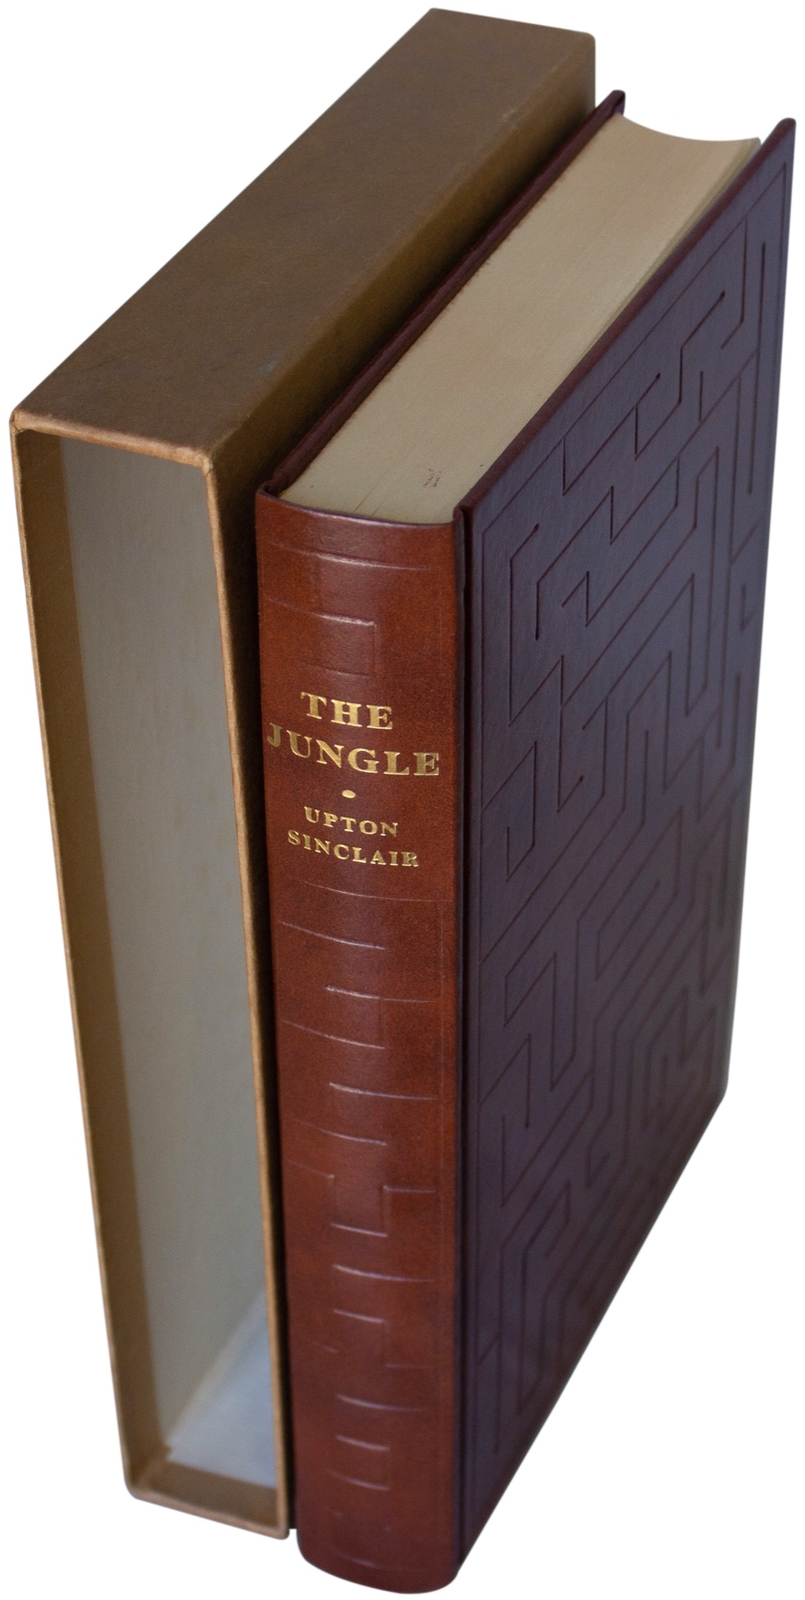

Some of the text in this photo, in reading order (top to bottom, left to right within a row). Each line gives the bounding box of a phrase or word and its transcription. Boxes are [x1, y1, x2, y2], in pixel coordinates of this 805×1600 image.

[301, 691, 393, 730] THE
[267, 722, 440, 776] JUNGLE
[304, 806, 398, 838] UPTON
[287, 829, 420, 868] SINCLAIR
